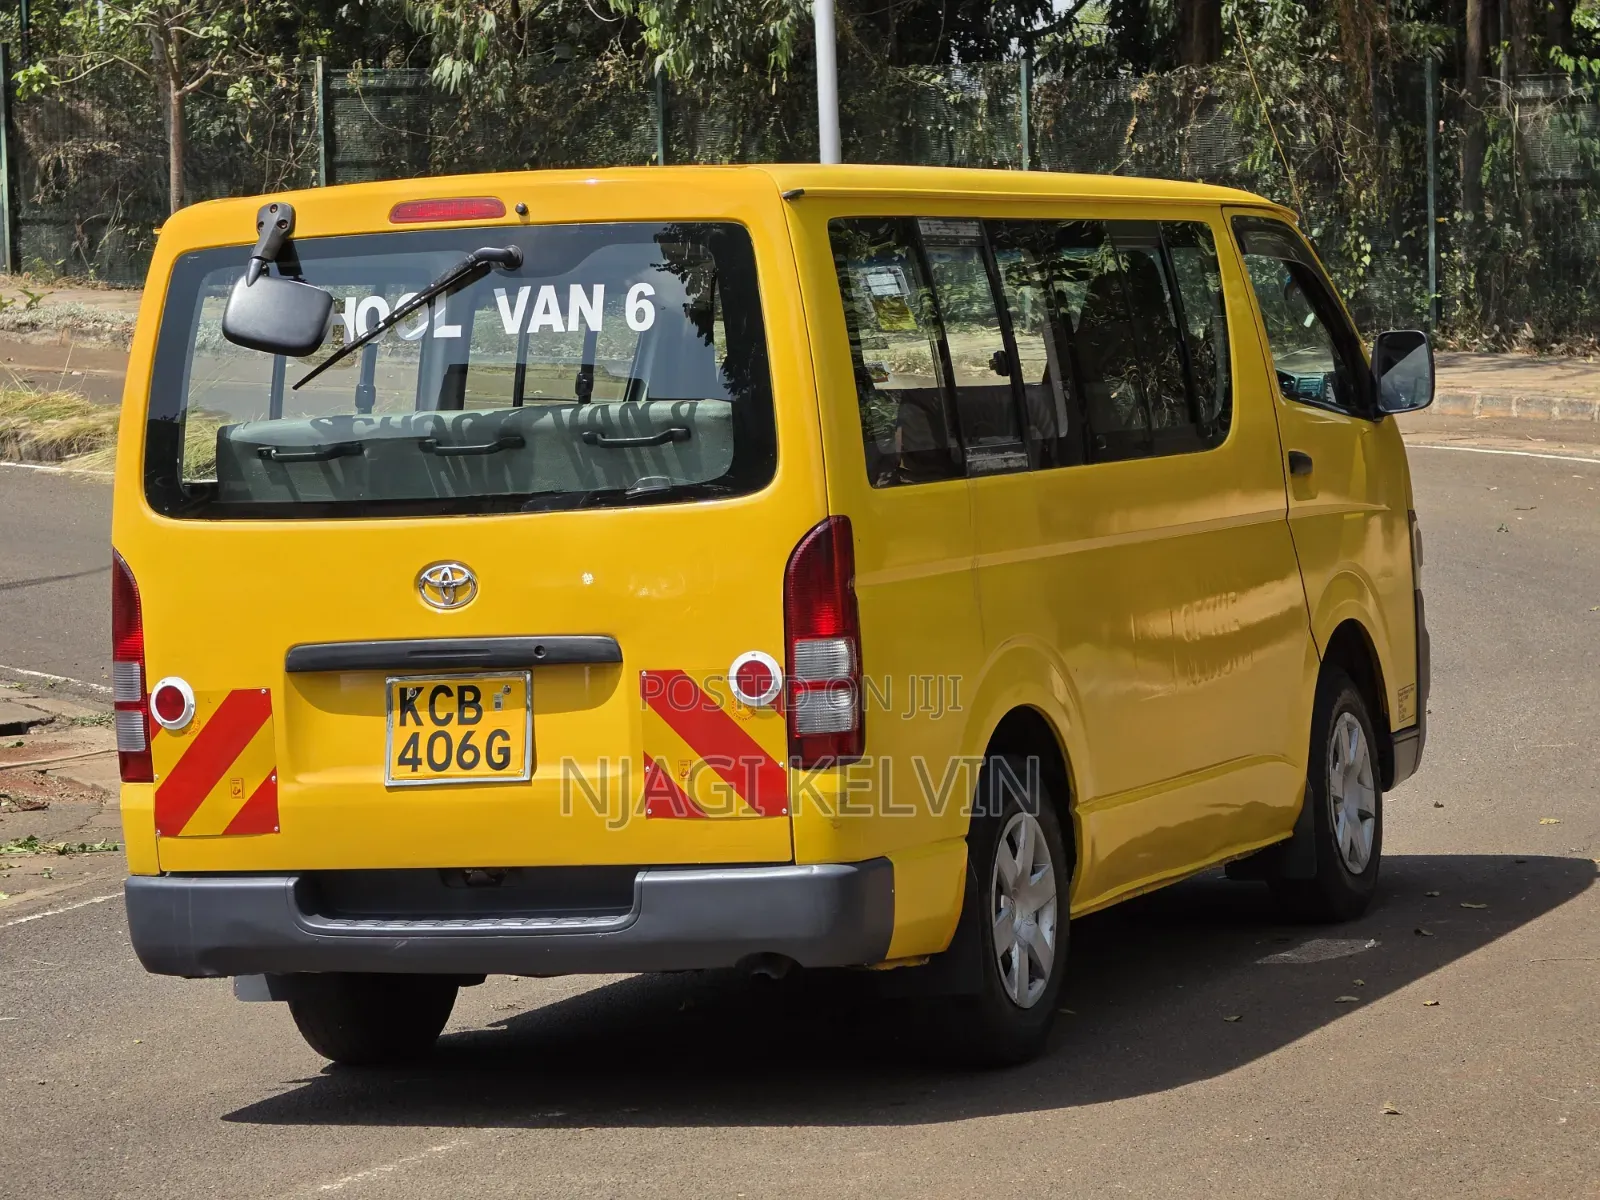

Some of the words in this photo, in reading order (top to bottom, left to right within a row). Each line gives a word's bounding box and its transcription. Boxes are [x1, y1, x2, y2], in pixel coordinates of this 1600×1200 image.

[323, 290, 462, 344] HOOL
[493, 284, 605, 335] VAN
[625, 282, 656, 332] 6
[399, 684, 483, 727] KCB
[397, 728, 511, 773] 406G
